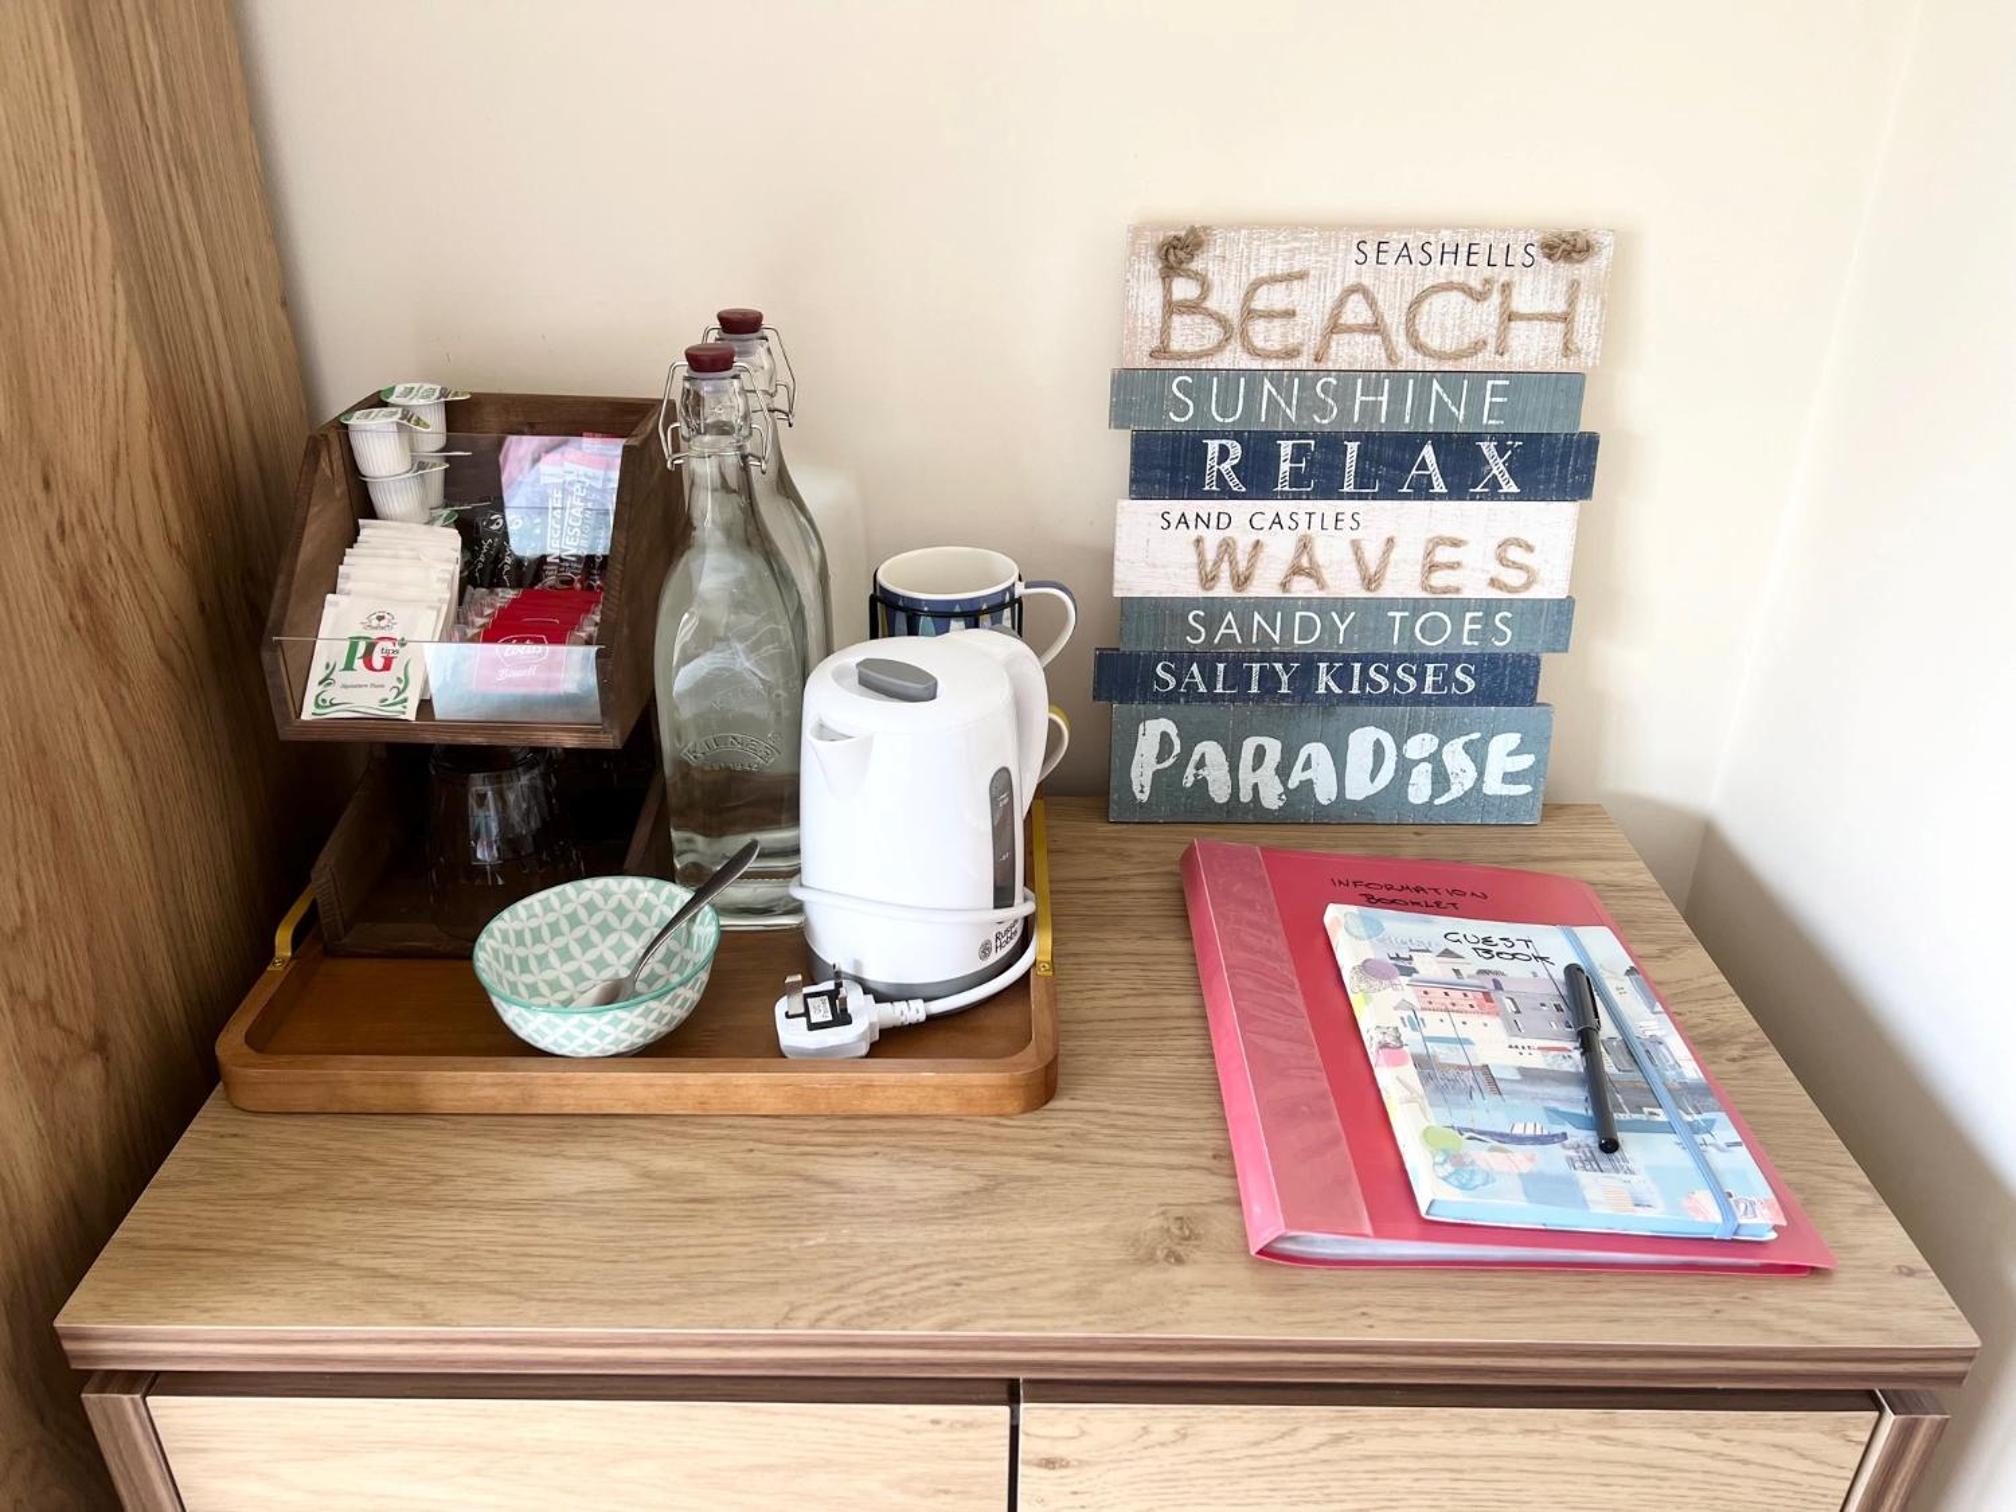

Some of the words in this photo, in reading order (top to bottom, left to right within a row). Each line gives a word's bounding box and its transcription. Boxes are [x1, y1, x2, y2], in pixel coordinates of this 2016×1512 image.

[1353, 239, 1538, 269] SEASHELLS
[1149, 266, 1581, 364] BEACH
[1168, 374, 1511, 426] SUNSHINE
[1200, 438, 1524, 495] RELAX
[1159, 509, 1233, 532] SAND
[1248, 510, 1363, 532] CASTLES
[1193, 535, 1540, 594] WAVES
[1185, 609, 1358, 646] SANDY
[1386, 609, 1514, 647] TOES
[339, 636, 398, 672] PG
[1152, 660, 1300, 695] SALTY
[1314, 661, 1478, 695] KISSES
[1330, 877, 1489, 900] INFORMATION
[1358, 892, 1461, 911] BOOKLET
[1443, 931, 1534, 949] GUEST
[1471, 946, 1556, 966] BOOK
